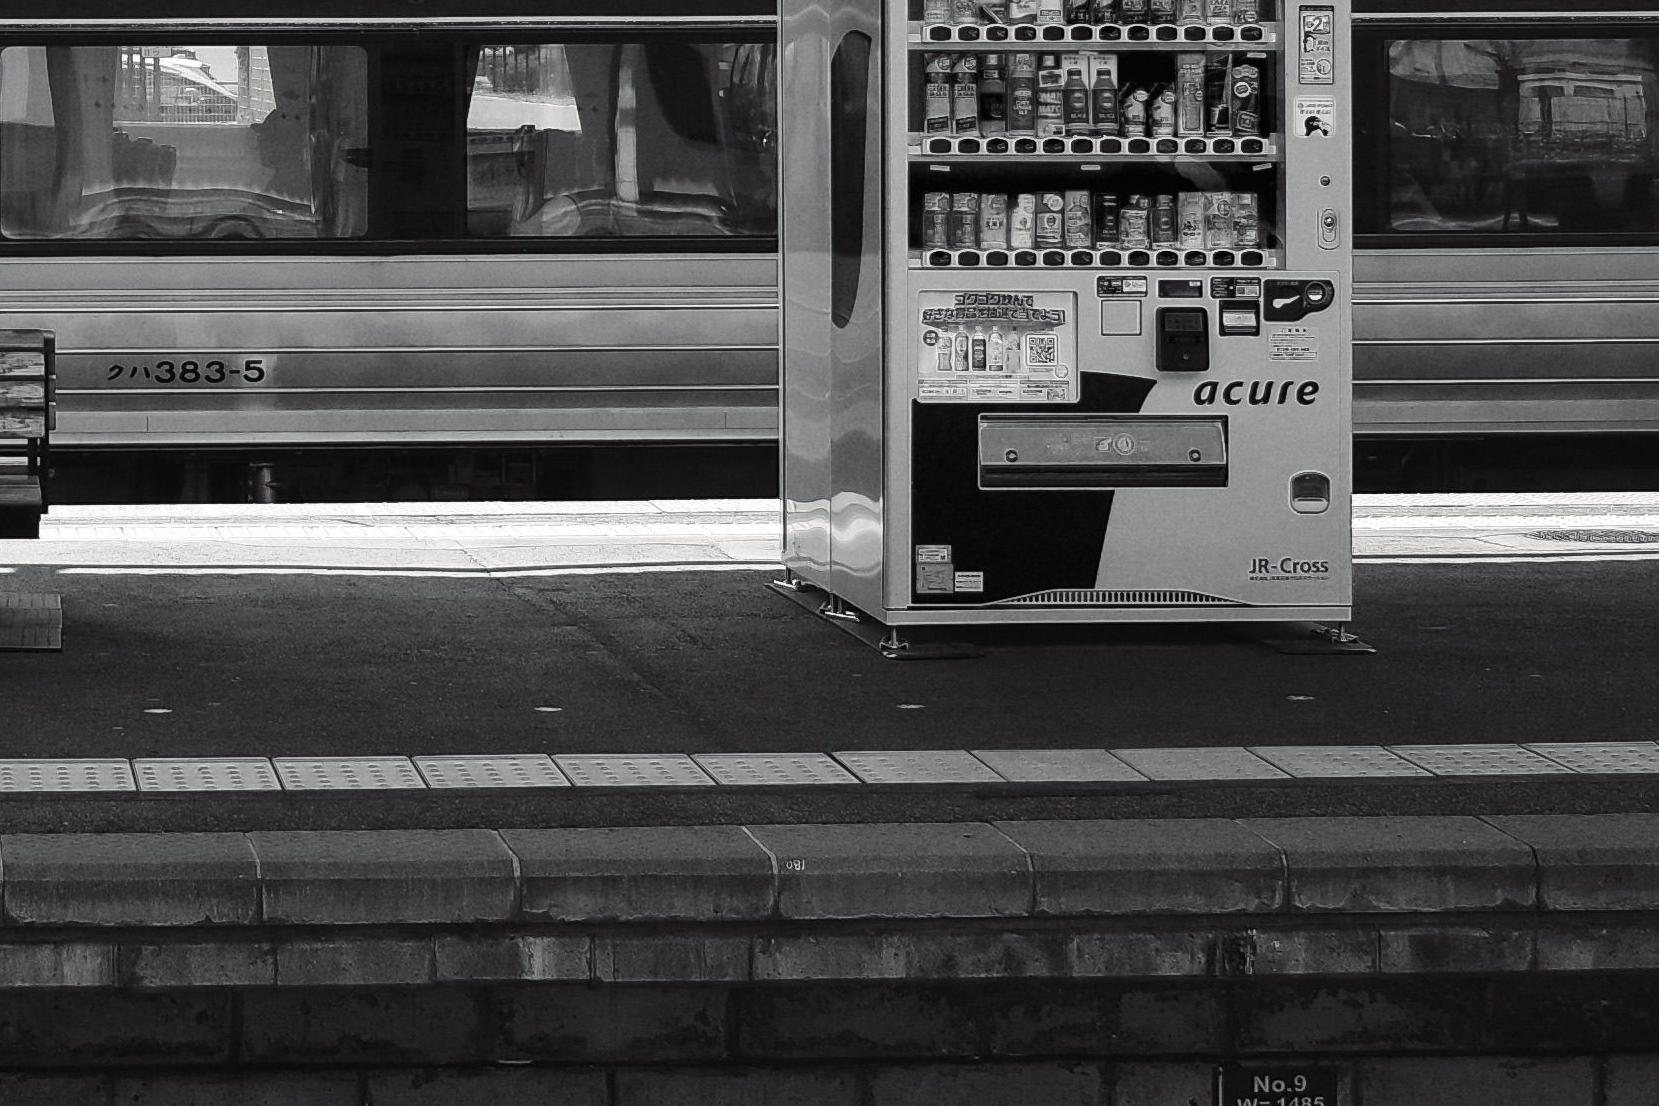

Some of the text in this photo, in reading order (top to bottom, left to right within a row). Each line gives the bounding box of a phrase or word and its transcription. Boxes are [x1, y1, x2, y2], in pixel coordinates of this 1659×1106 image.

[107, 360, 265, 384] クハ383-5
[1193, 380, 1320, 406] acure
[1248, 557, 1330, 574] JR-Cross
[1253, 1074, 1307, 1093] No.9
